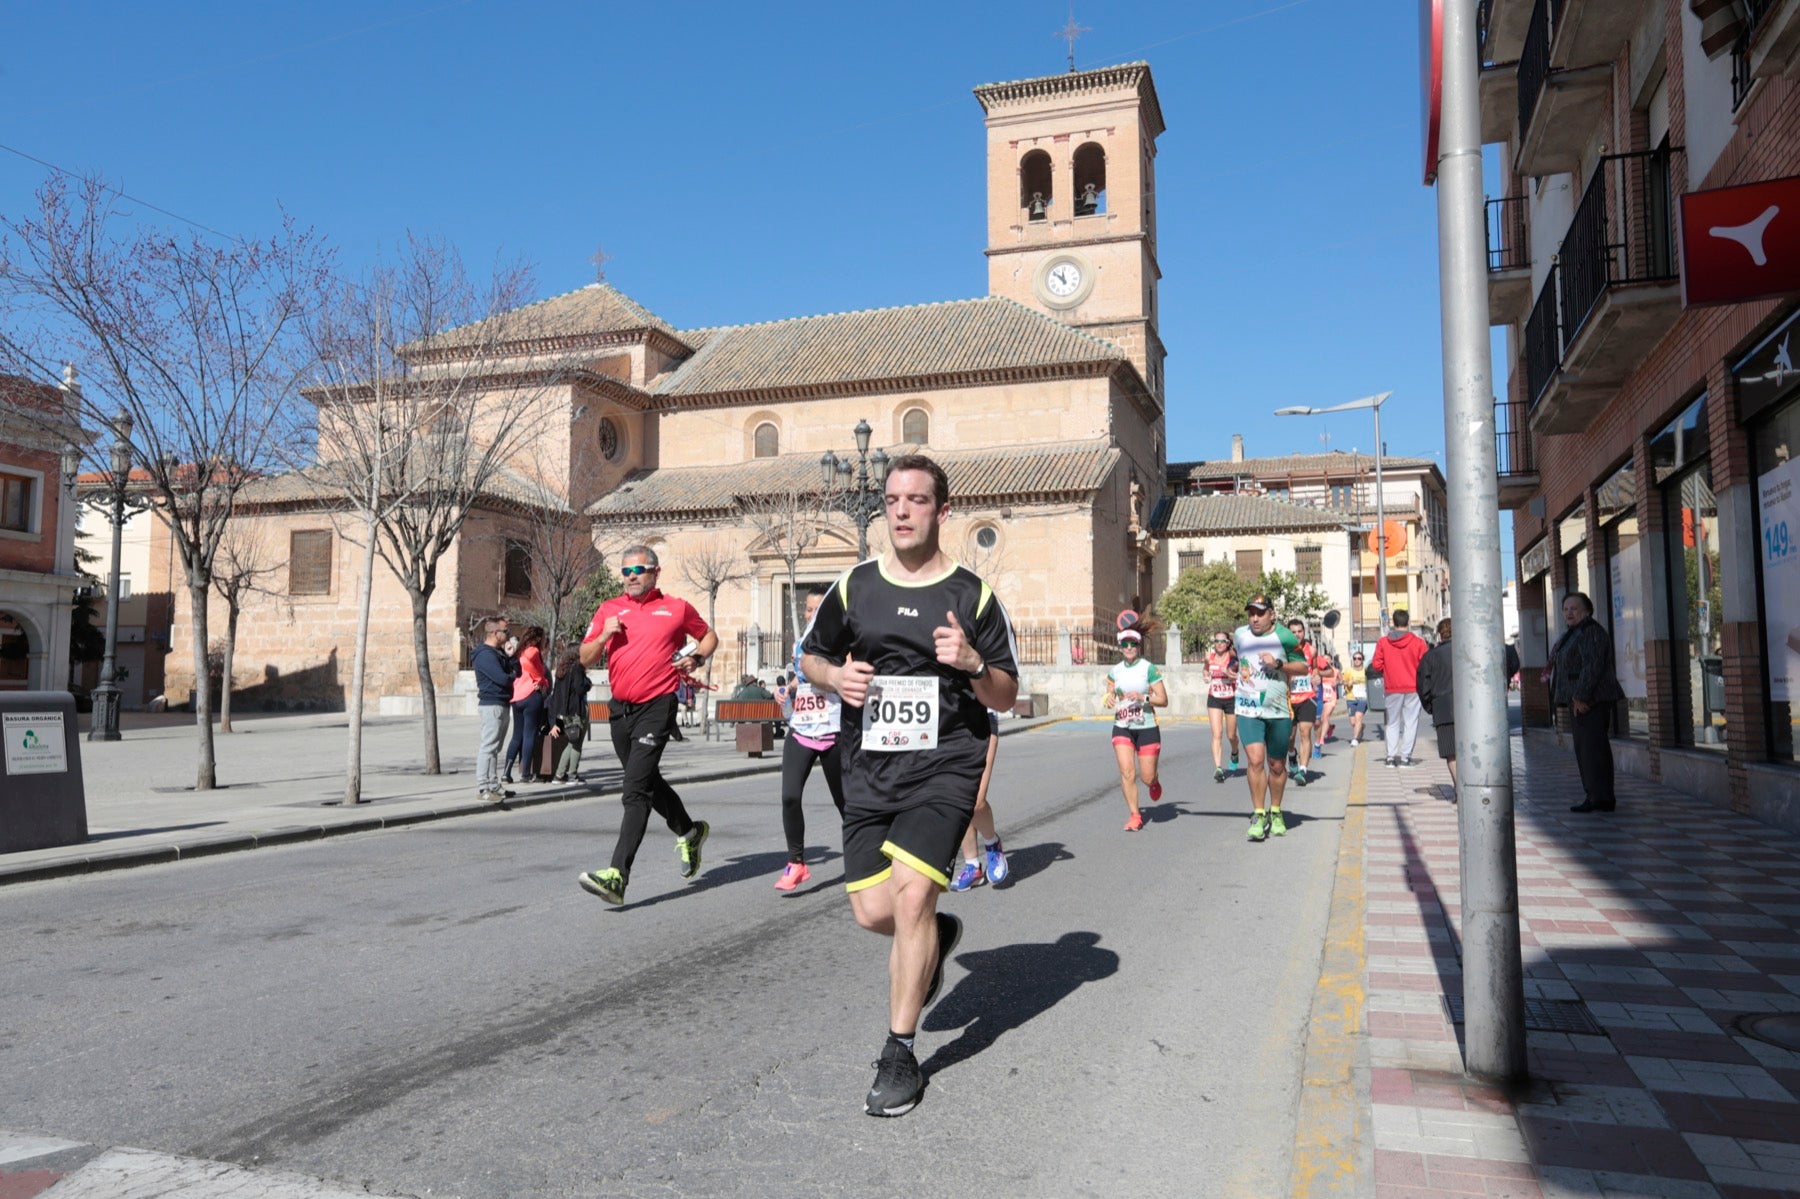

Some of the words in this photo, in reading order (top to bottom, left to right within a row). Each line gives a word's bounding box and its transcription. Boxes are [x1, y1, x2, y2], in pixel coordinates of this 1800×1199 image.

[1766, 521, 1788, 560] 149
[897, 606, 919, 617] FILA
[796, 695, 826, 712] 2256
[870, 700, 931, 724] 3059
